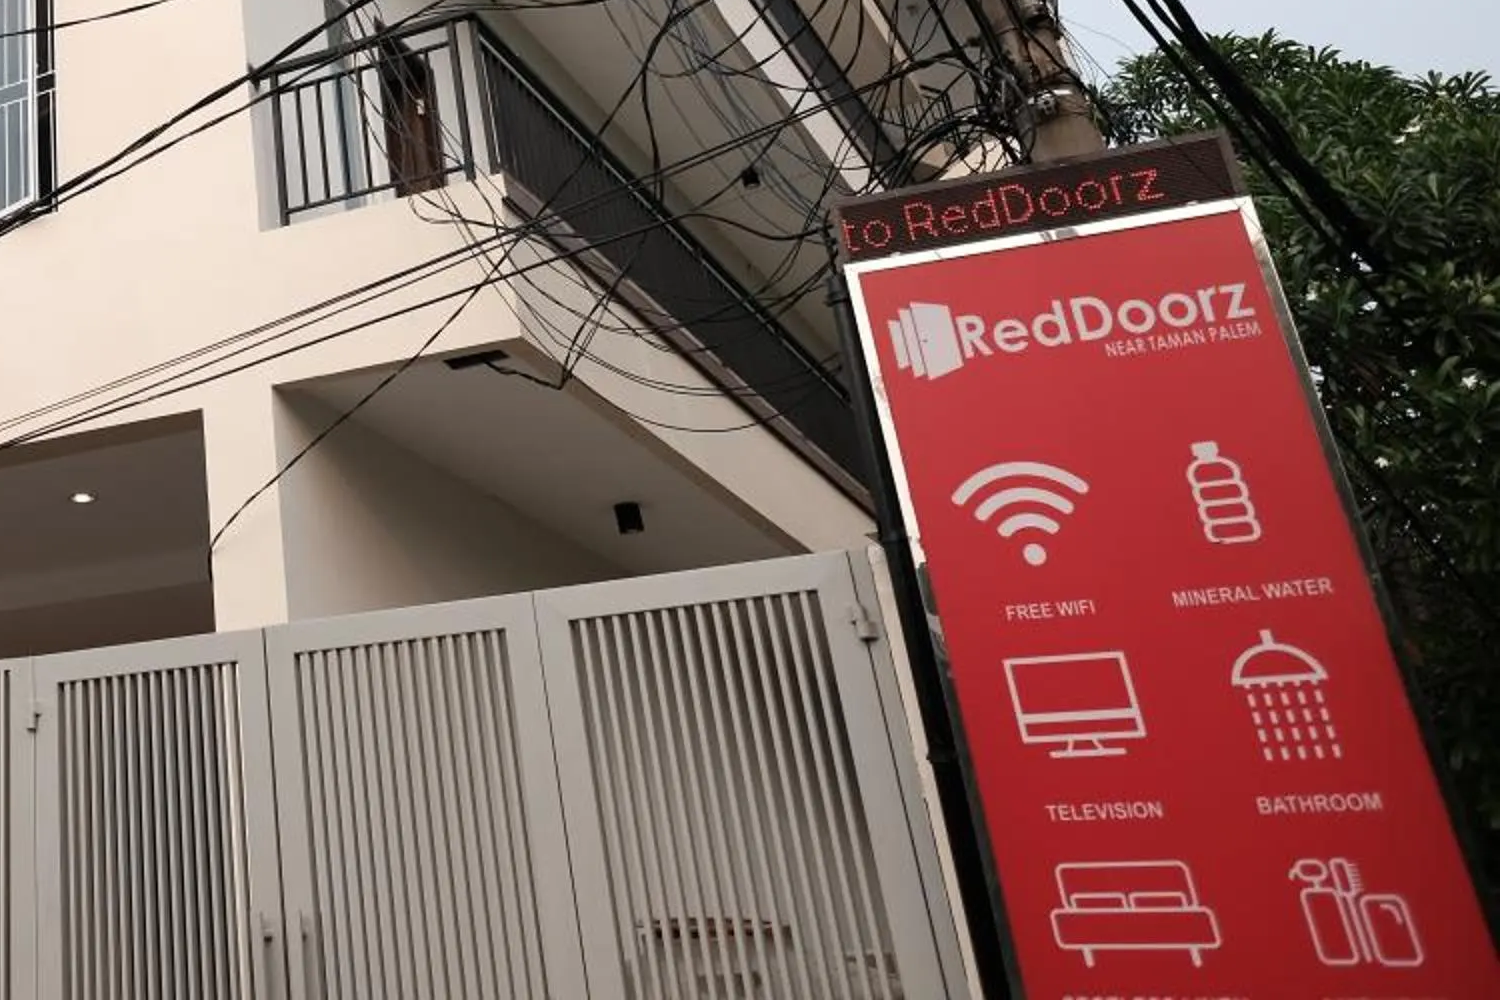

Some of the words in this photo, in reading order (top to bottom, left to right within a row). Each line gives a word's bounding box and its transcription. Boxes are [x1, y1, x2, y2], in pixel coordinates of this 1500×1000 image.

[841, 218, 892, 251] to
[903, 167, 1165, 241] RedDoorz
[955, 283, 1256, 359] RedDoorz
[1104, 336, 1146, 359] NEAR
[1149, 328, 1206, 352] TAMAN
[1206, 320, 1263, 343] PALEM
[1171, 584, 1260, 609] MINERAL
[1261, 577, 1334, 600] WATER
[1005, 602, 1054, 621] FREE
[1056, 599, 1096, 617] WIFI
[1045, 801, 1164, 821] TELEVISION
[1255, 792, 1383, 815] BATHROOM
